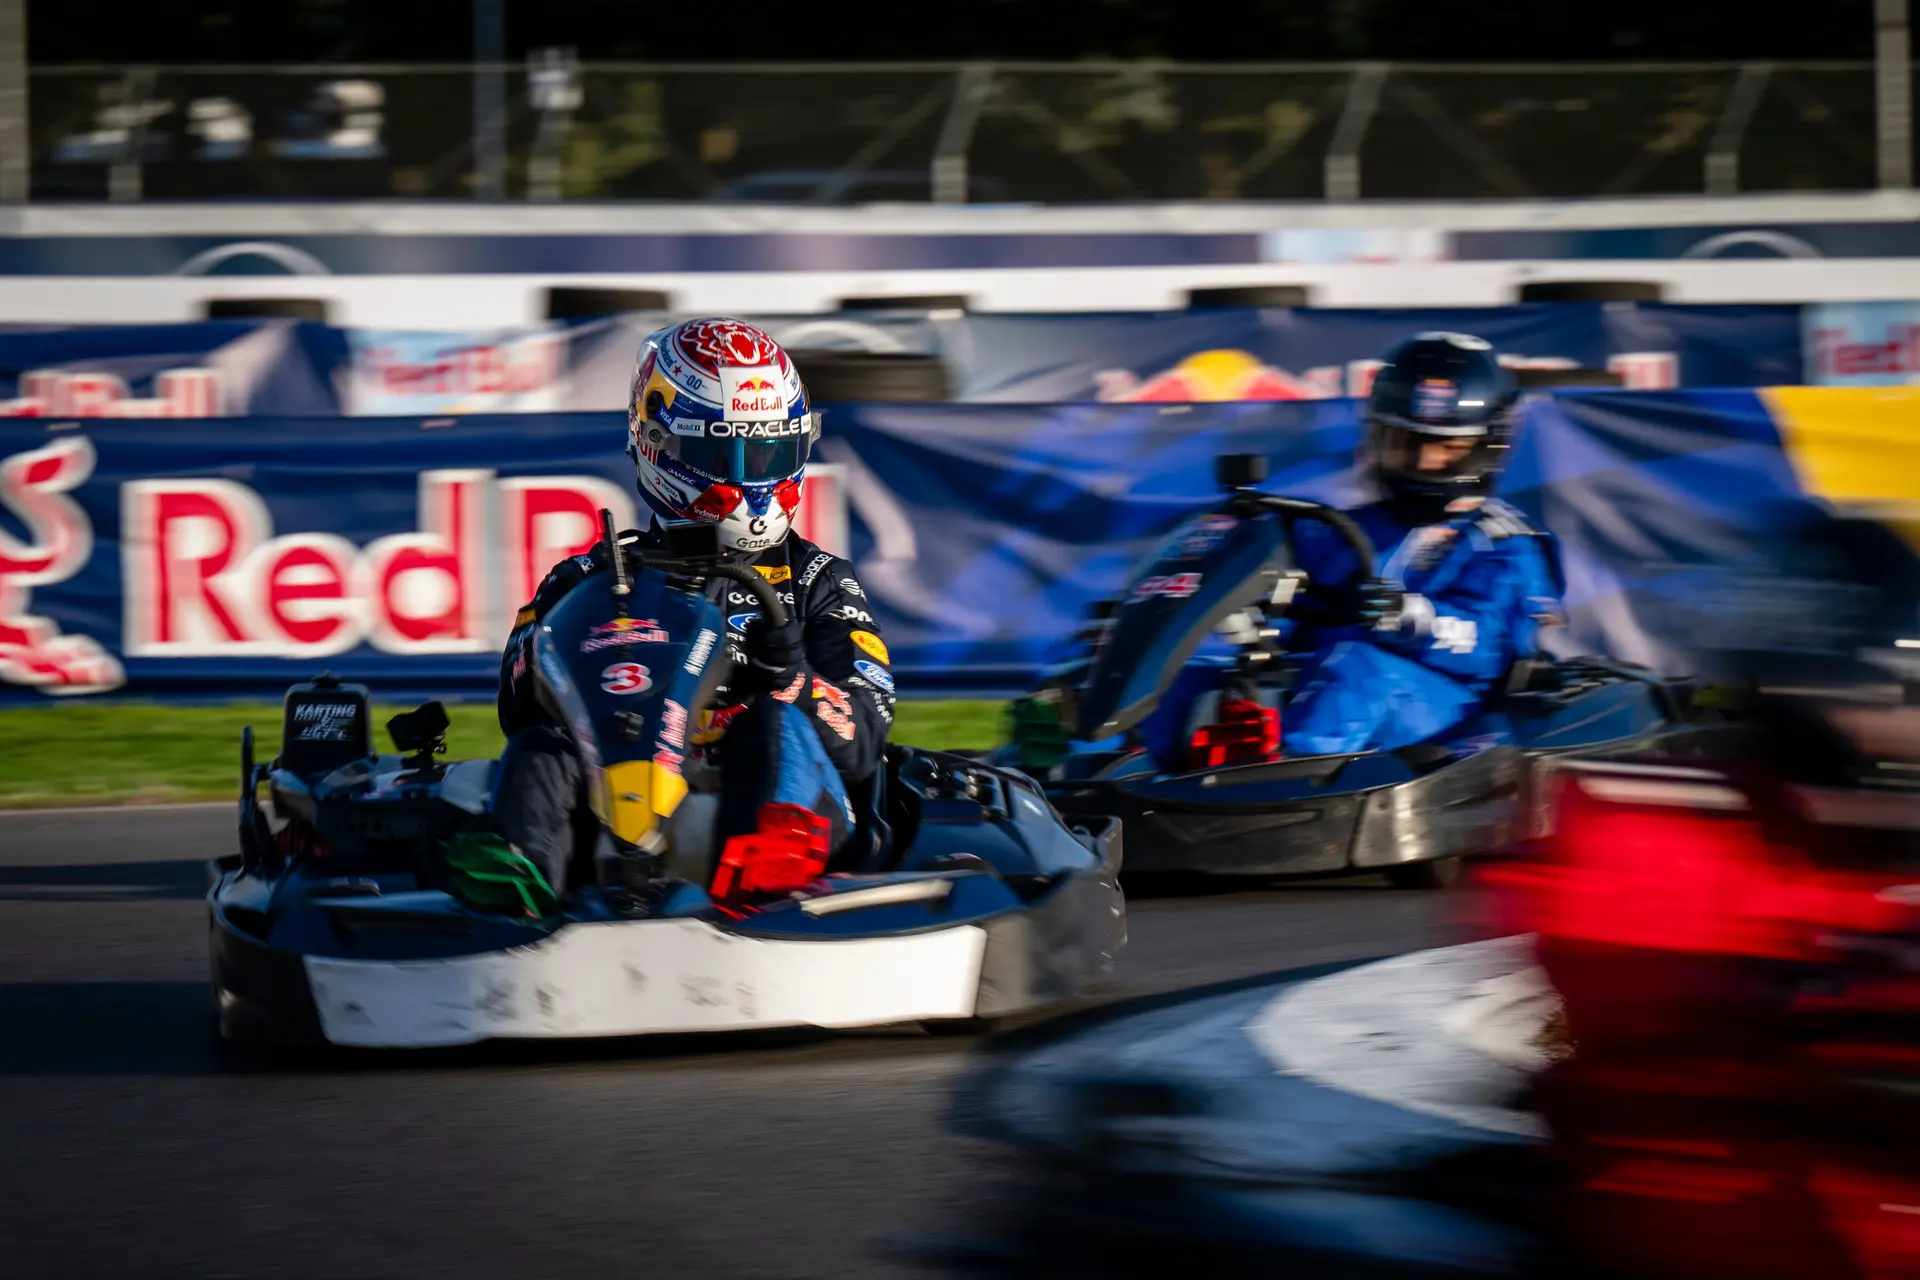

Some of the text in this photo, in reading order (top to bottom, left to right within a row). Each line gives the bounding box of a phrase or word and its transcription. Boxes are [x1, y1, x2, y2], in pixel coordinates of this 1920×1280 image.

[732, 396, 783, 411] Red Bull
[660, 409, 673, 425] VISA
[676, 423, 693, 431] Mobil
[710, 418, 800, 437] ORACLE
[736, 537, 771, 549] Gate
[121, 468, 500, 657] Red
[745, 591, 795, 606] Gte
[600, 662, 653, 695] 3
[293, 704, 357, 720] KARTING
